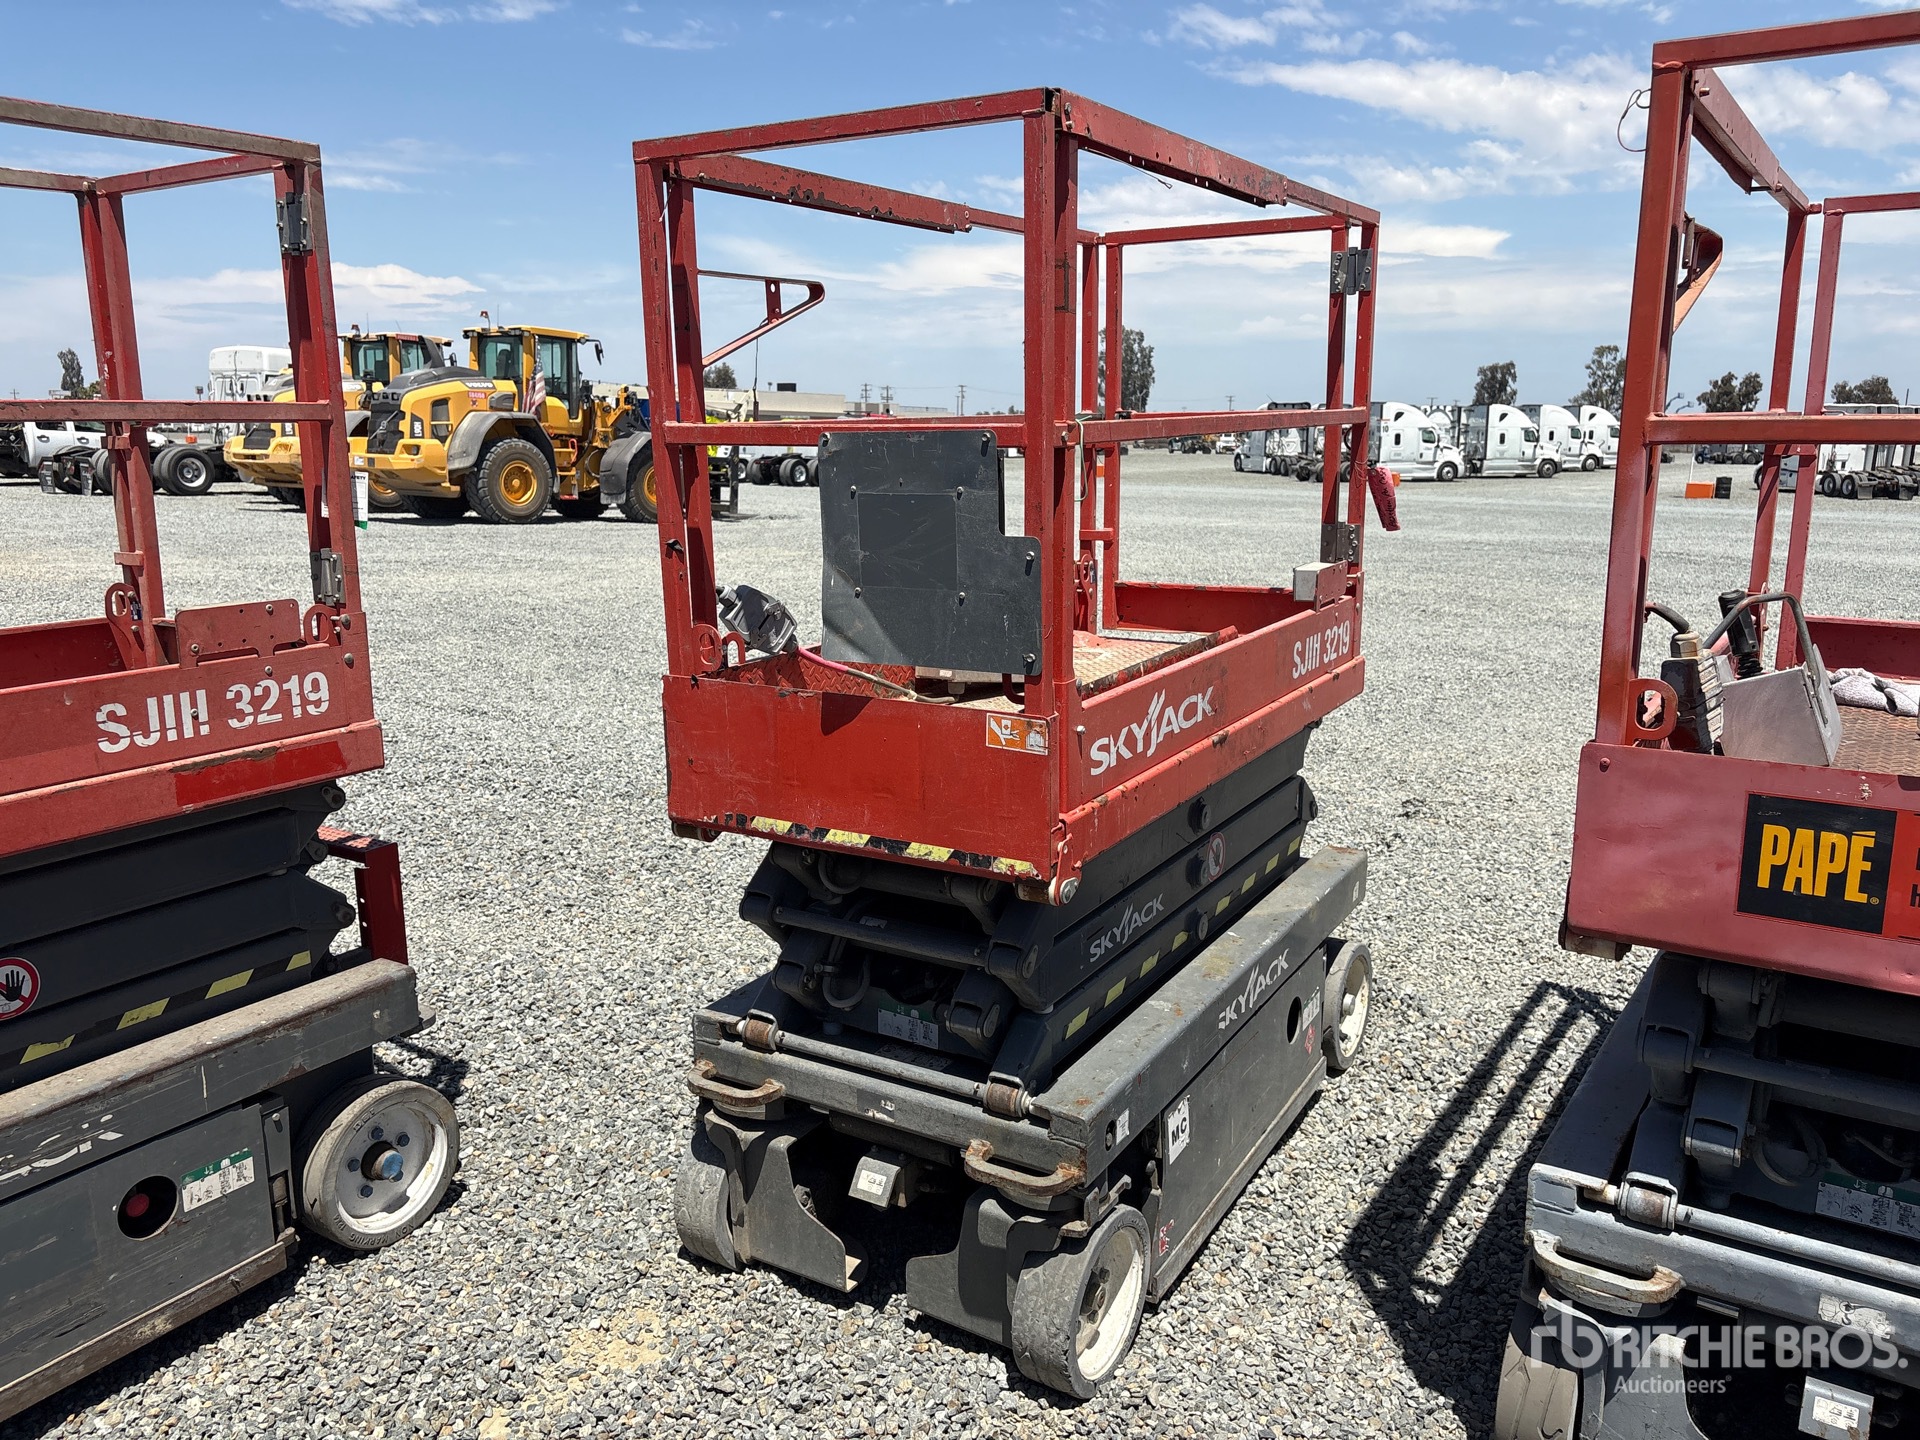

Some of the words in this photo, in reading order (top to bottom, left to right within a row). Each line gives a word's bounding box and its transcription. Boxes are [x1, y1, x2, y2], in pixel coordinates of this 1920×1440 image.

[414, 421, 423, 437] L90H
[1323, 620, 1350, 664] 3219
[225, 671, 330, 730] 3219
[1090, 686, 1215, 776] SKYJACK
[1757, 823, 1876, 904] PAPÉ
[1089, 893, 1164, 963] SKYJACK
[1171, 1117, 1188, 1146] MC
